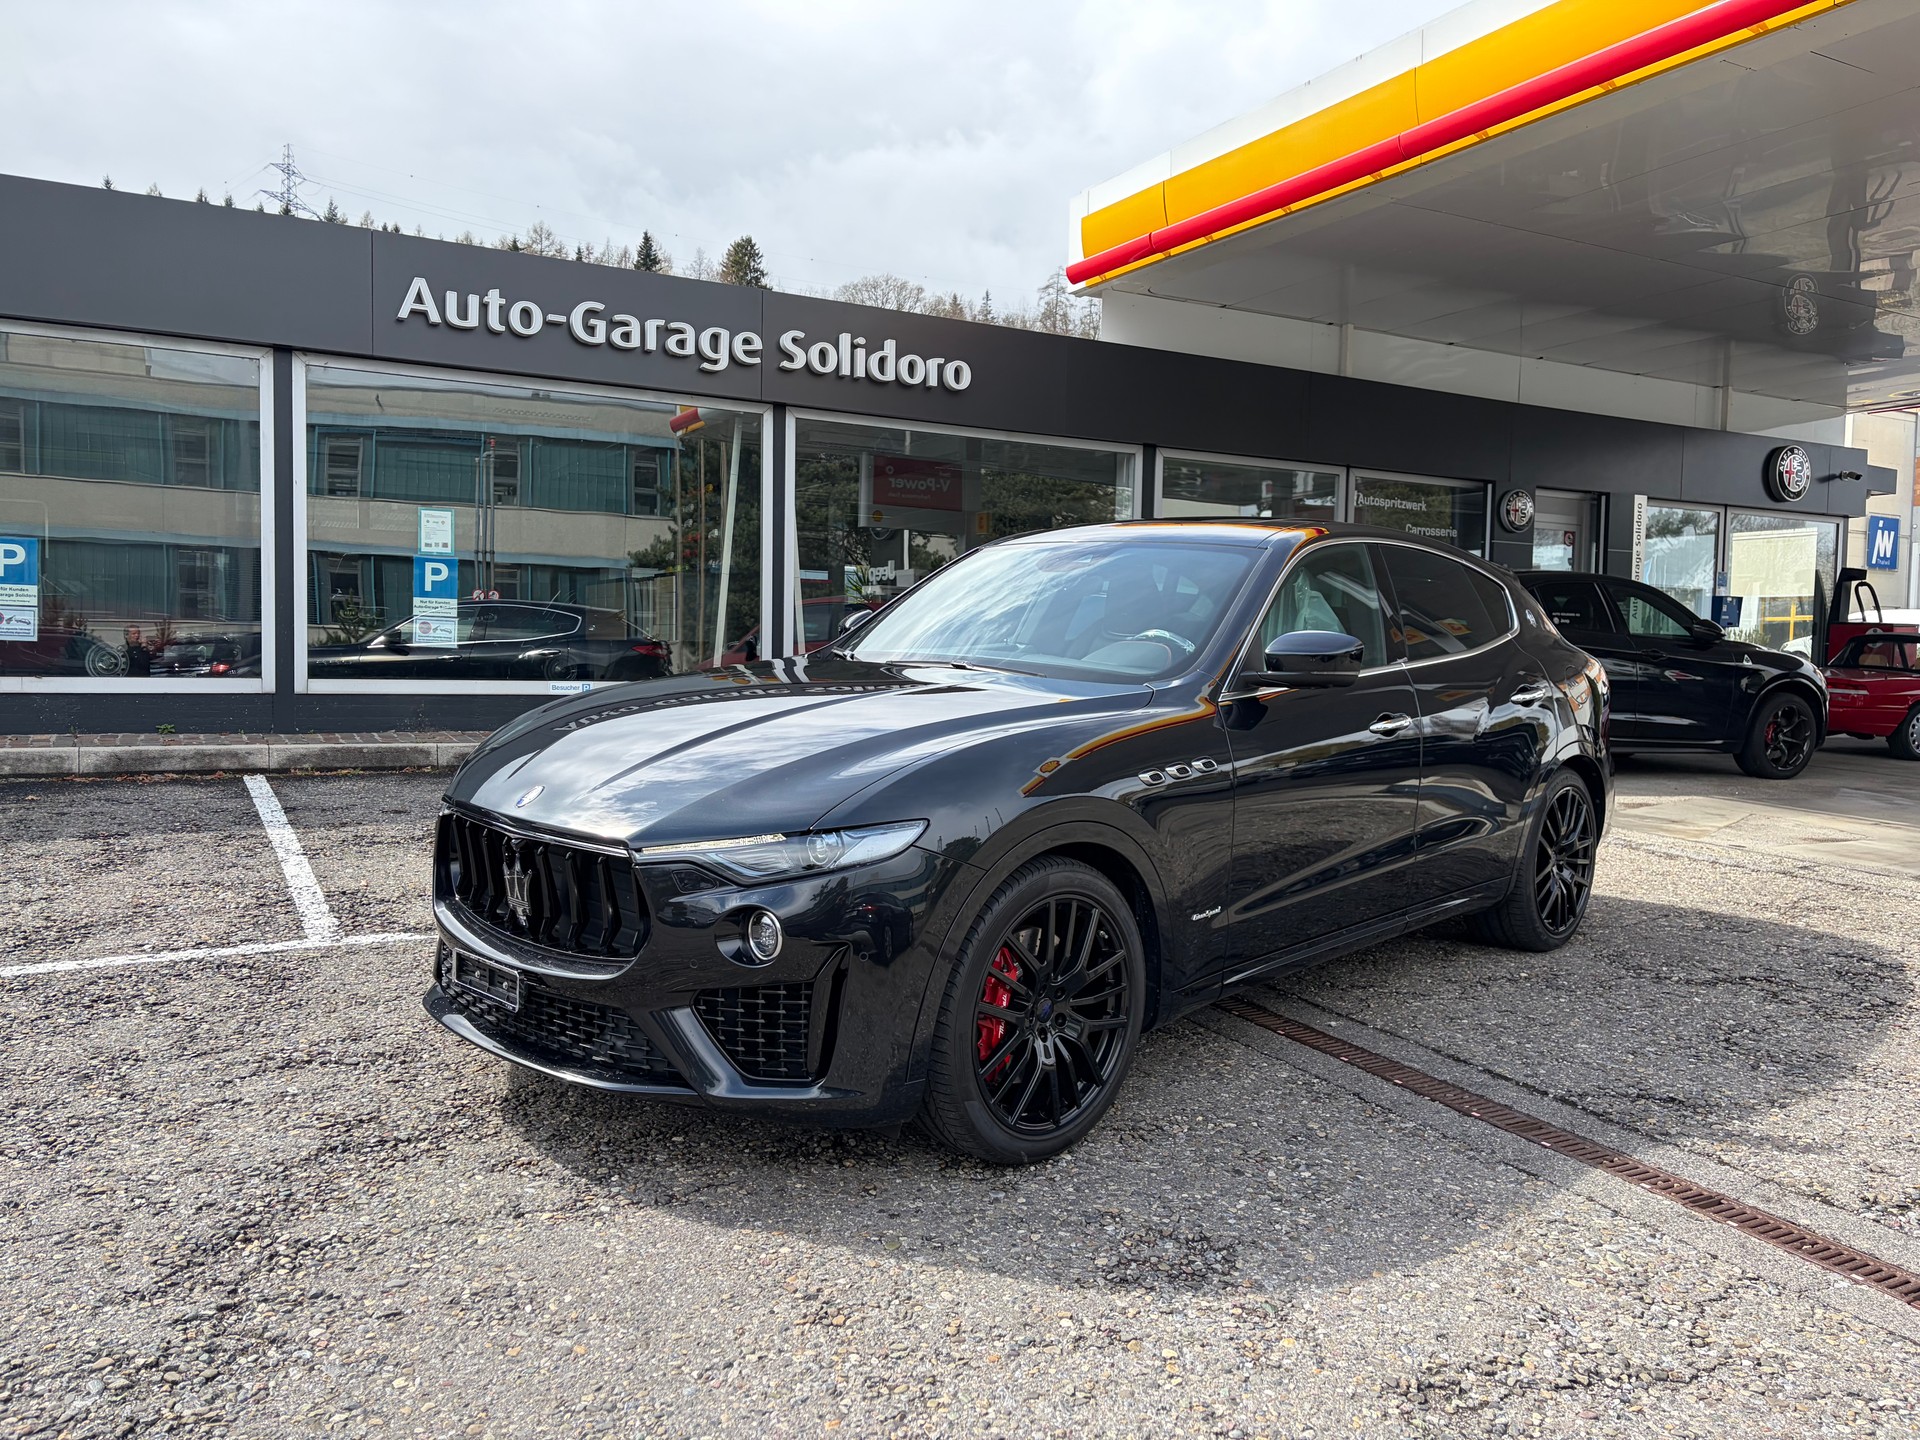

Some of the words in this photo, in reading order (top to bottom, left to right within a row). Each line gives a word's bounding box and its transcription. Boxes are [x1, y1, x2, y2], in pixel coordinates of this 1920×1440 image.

[397, 276, 763, 372] Auto-Garage
[778, 329, 973, 393] Solidoro
[1358, 493, 1427, 511] Autospritzwerk
[1405, 523, 1458, 538] Carrosserie
[1635, 502, 1643, 547] Solidoro
[0, 543, 26, 577] P
[424, 561, 449, 592] P
